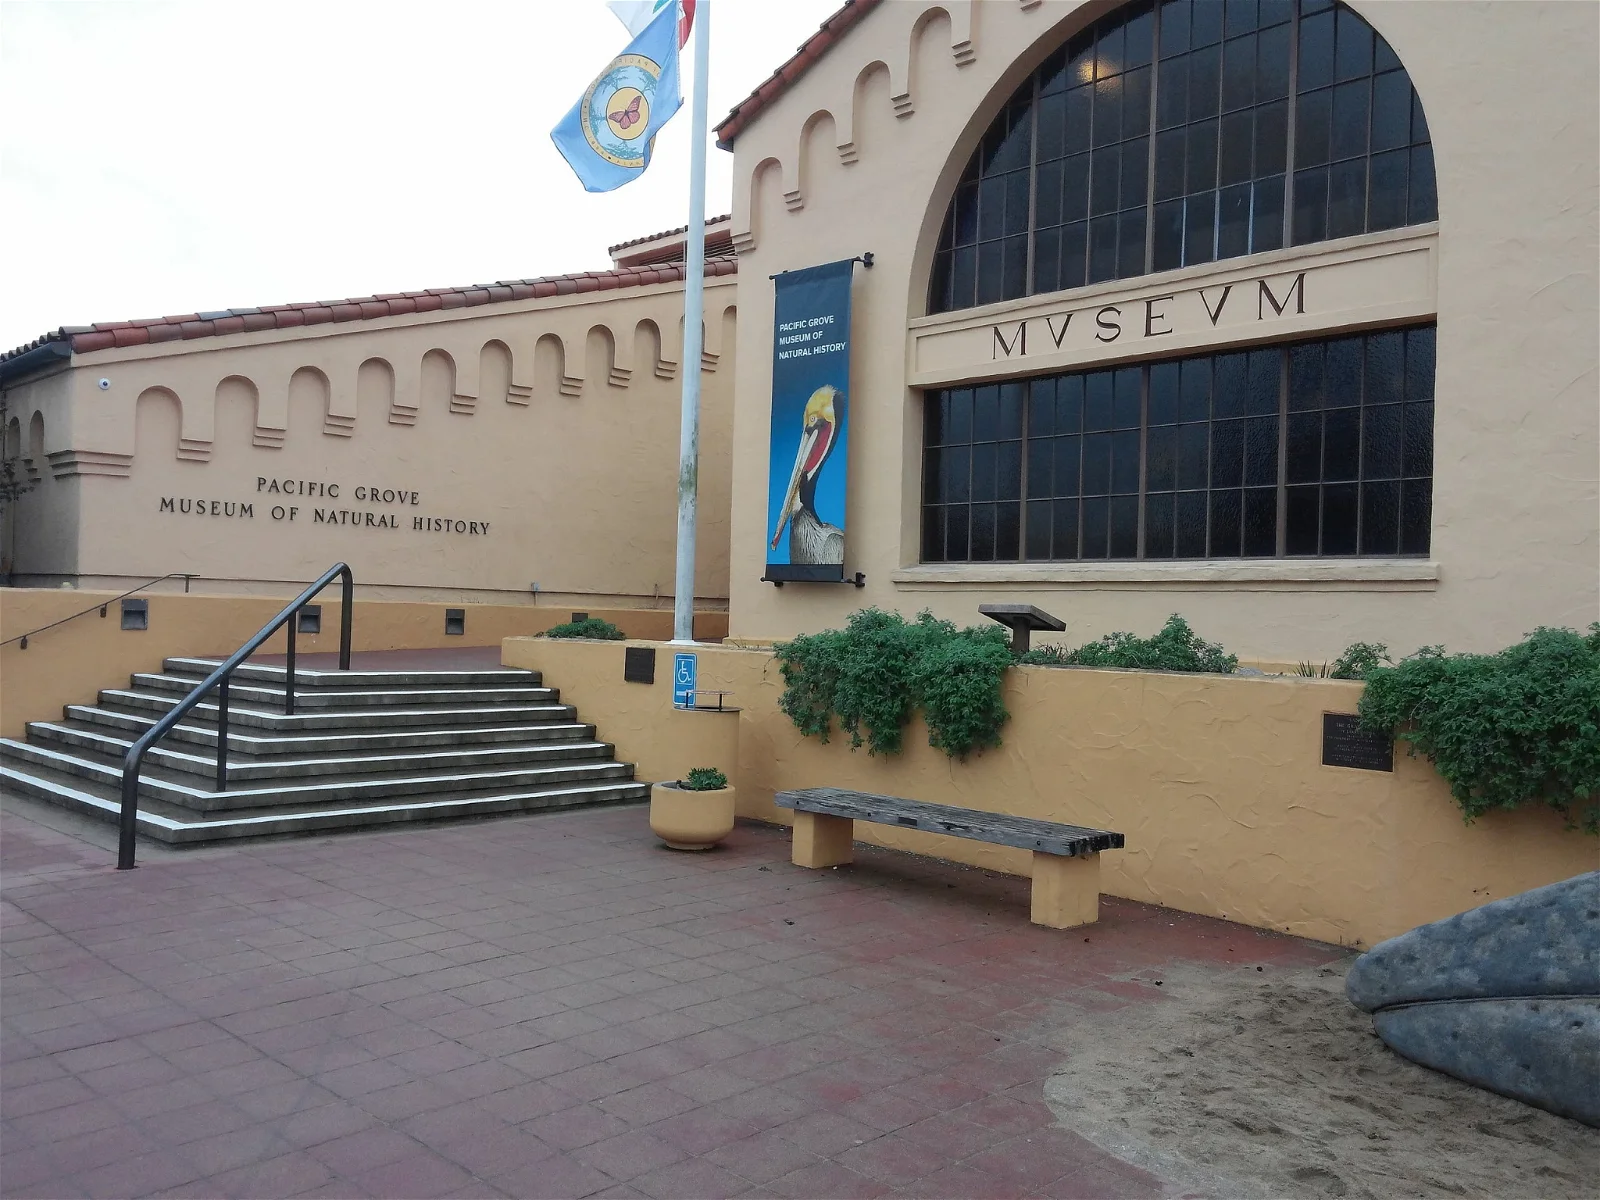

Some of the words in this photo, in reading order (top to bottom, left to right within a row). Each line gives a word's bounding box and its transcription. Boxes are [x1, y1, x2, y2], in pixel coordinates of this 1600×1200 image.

[779, 320, 807, 332] PACIFIC
[808, 315, 834, 327] GROVE
[992, 272, 1307, 360] MVSEVM
[779, 333, 811, 345] MUSEUM
[812, 331, 823, 340] OF
[778, 347, 812, 360] NATURAL
[813, 342, 846, 355] HISTORY
[256, 476, 340, 498] PACIFIC
[355, 486, 420, 506] GROVE
[159, 496, 255, 518] MUSEUM
[271, 505, 299, 521] OF
[313, 508, 400, 529] NATURAL
[413, 516, 491, 536] HISTORY
